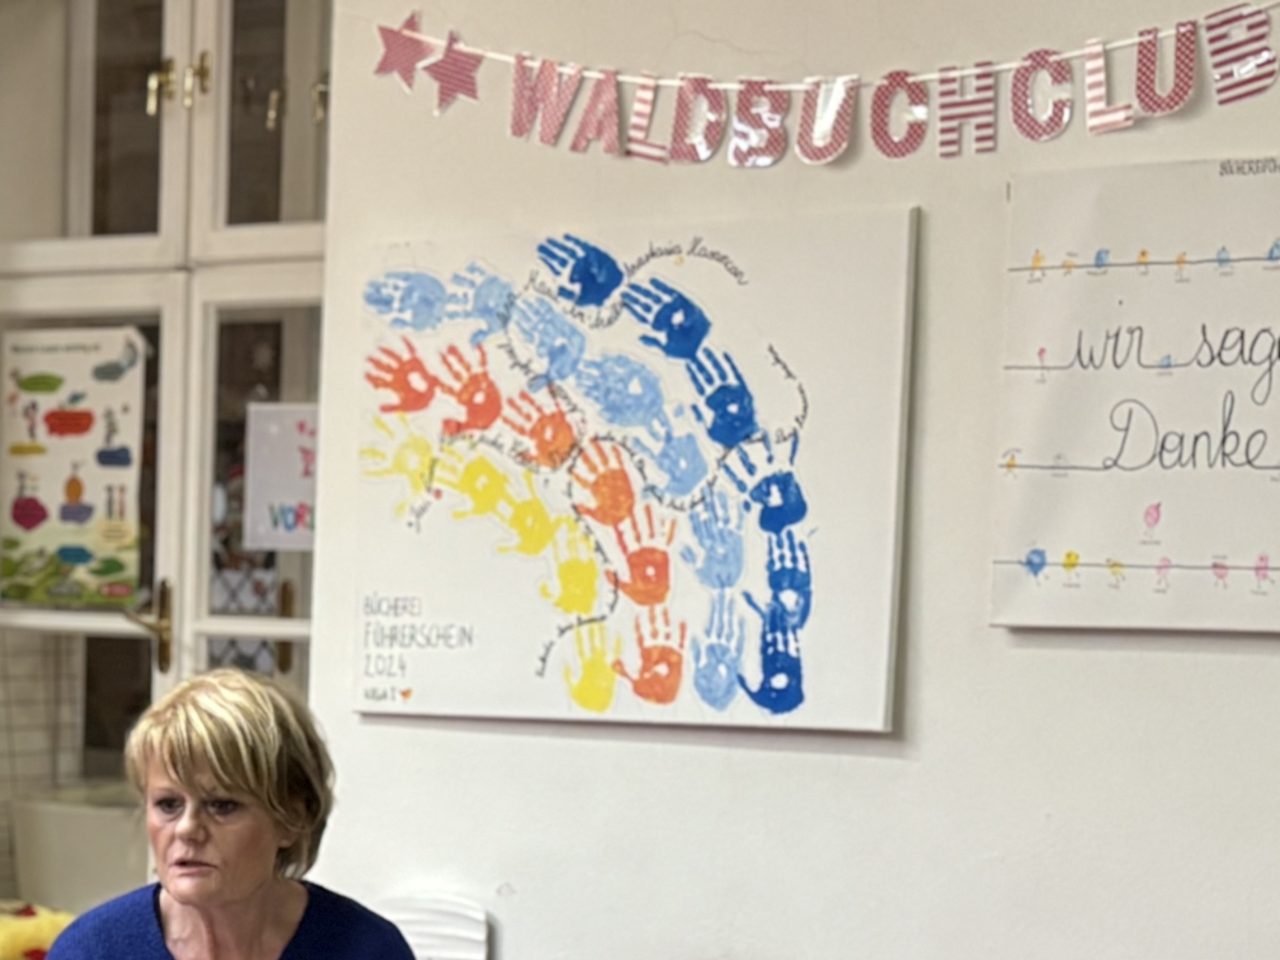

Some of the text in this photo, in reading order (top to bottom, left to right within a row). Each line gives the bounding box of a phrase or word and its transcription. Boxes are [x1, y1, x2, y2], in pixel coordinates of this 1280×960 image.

[510, 3, 1278, 168] WALDBUCHCLUB
[1070, 299, 1280, 406] wir sag
[1103, 390, 1267, 471] Danke
[363, 621, 474, 649] FÜHRERSCHEIN
[364, 653, 406, 678] 2024
